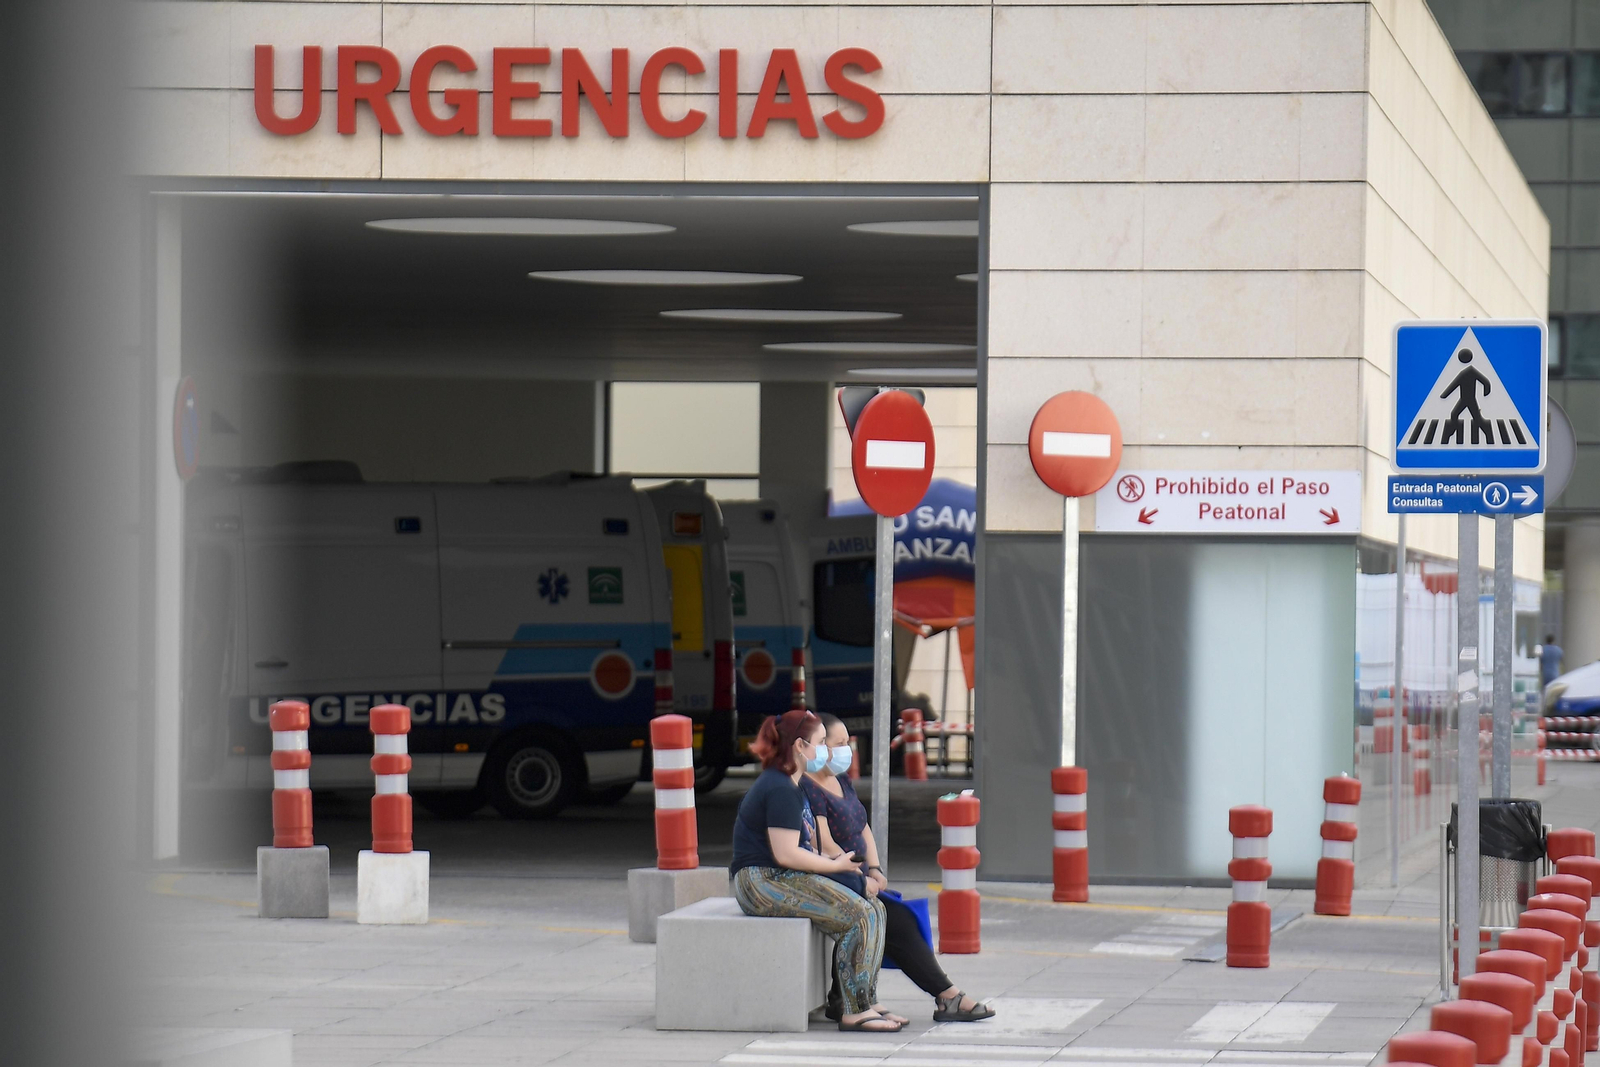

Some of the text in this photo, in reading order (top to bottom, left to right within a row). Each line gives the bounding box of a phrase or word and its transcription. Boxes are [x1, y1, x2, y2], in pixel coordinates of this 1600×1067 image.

[254, 44, 886, 139] URGENCIAS
[1155, 477, 1330, 495] Prohibido el Paso
[1392, 482, 1482, 493] Entrada Peatonal
[1198, 502, 1286, 520] Peatonal
[1392, 497, 1443, 507] Consultas
[893, 537, 976, 563] ANZA
[249, 693, 506, 723] UGECIAS
